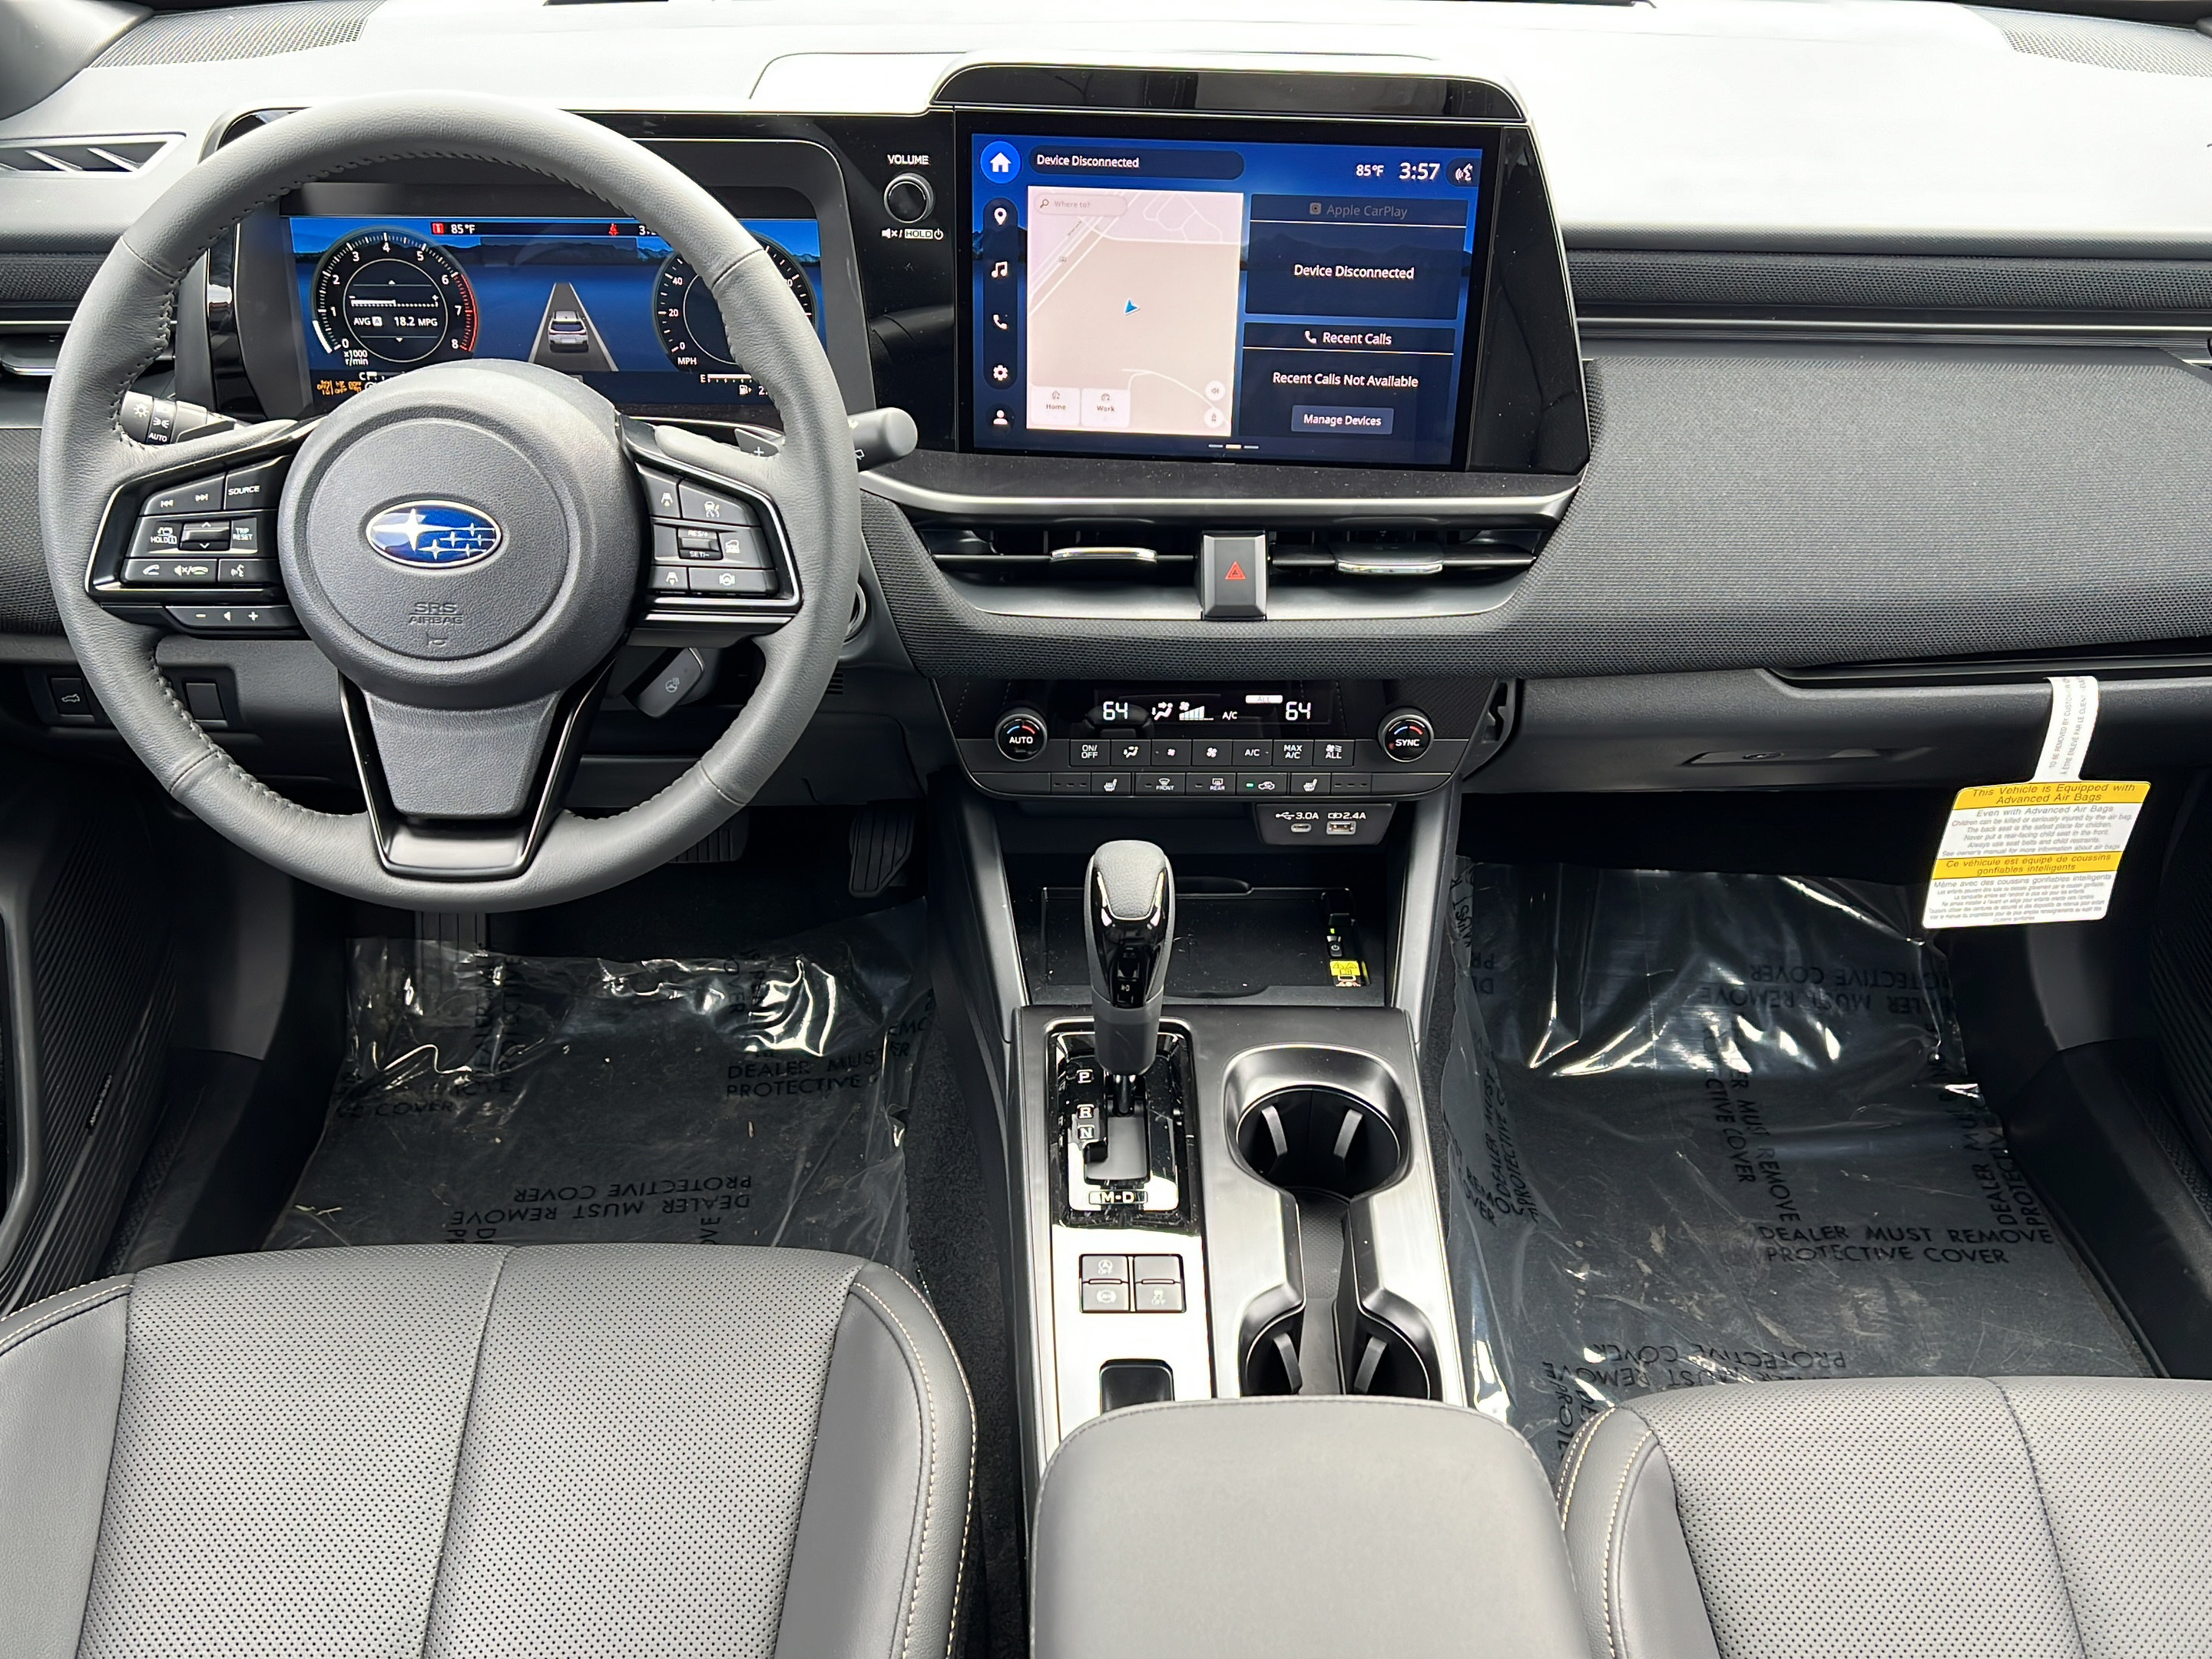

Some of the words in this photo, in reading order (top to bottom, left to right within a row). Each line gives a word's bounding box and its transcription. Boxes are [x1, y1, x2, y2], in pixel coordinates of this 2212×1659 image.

[887, 154, 930, 165] VOLUME
[1037, 154, 1069, 166] Device
[1071, 155, 1139, 168] Disconnected
[1356, 164, 1385, 177] 85°F
[1399, 162, 1441, 180] 3:57
[1326, 204, 1360, 217] Apple
[1363, 205, 1408, 220] CarPlay
[451, 224, 475, 233] 85°F
[383, 243, 390, 252] 4
[353, 251, 359, 261] 3
[417, 251, 424, 261] 5
[1294, 264, 1333, 276] Device
[1335, 265, 1415, 280] Disconnected
[333, 275, 340, 285] 2
[442, 275, 449, 285] 6
[673, 277, 683, 286] 40
[330, 307, 336, 316] 1
[455, 306, 462, 316] 7
[669, 309, 679, 317] 20
[394, 316, 416, 326] 18.2
[418, 318, 438, 326] MPG
[342, 339, 349, 348] 0
[452, 339, 459, 349] 8
[1323, 332, 1363, 344] Recent
[1364, 333, 1392, 345] Calls
[679, 342, 686, 350] 0
[345, 357, 369, 366] r/min
[700, 375, 706, 383] E
[1273, 372, 1313, 384] Recent
[1314, 373, 1341, 385] Calls
[1343, 374, 1365, 386] Not
[1366, 376, 1419, 388] Available
[1303, 414, 1343, 426] Manage
[1344, 416, 1382, 426] Devices
[148, 432, 168, 442] AUTO
[228, 485, 260, 495] SOURCE
[414, 602, 458, 614] SRS
[409, 616, 463, 625] AIRBAG
[1102, 701, 1128, 720] 64
[1222, 711, 1238, 720] A/C
[1285, 701, 1312, 720] 64
[1285, 751, 1300, 760] A/C
[2000, 785, 2037, 795] Vehicle
[2057, 784, 2108, 796] Equipped
[1996, 793, 2048, 804] Advanced
[2075, 793, 2101, 803] Bags
[2025, 806, 2070, 815] Advanced
[2090, 805, 2114, 813] Bags
[1963, 858, 2001, 866] véhicule
[2022, 856, 2052, 866] équipé
[2028, 864, 2076, 873] intelligents
[729, 1060, 810, 1079] DEALER
[1079, 1071, 1090, 1083] P
[727, 1075, 860, 1097] PROTECTIVE
[1079, 1107, 1092, 1118] R
[1079, 1128, 1093, 1139] N
[1723, 1128, 1757, 1183] COVER
[609, 1175, 752, 1196] PROTECTIVE
[1755, 1147, 1801, 1222] REMOVE
[513, 1185, 596, 1203] COVER
[1972, 1164, 2018, 1226] DEALER
[572, 1200, 644, 1219] MUST
[662, 1194, 751, 1214] DEALER
[450, 1207, 558, 1226] REMOVE
[1756, 1225, 1849, 1243] DEALER
[1864, 1225, 1933, 1243] MUST
[1949, 1229, 2056, 1244] REMOVE
[1767, 1244, 1915, 1263] PROTECTIVE
[1923, 1247, 2010, 1264] COVER
